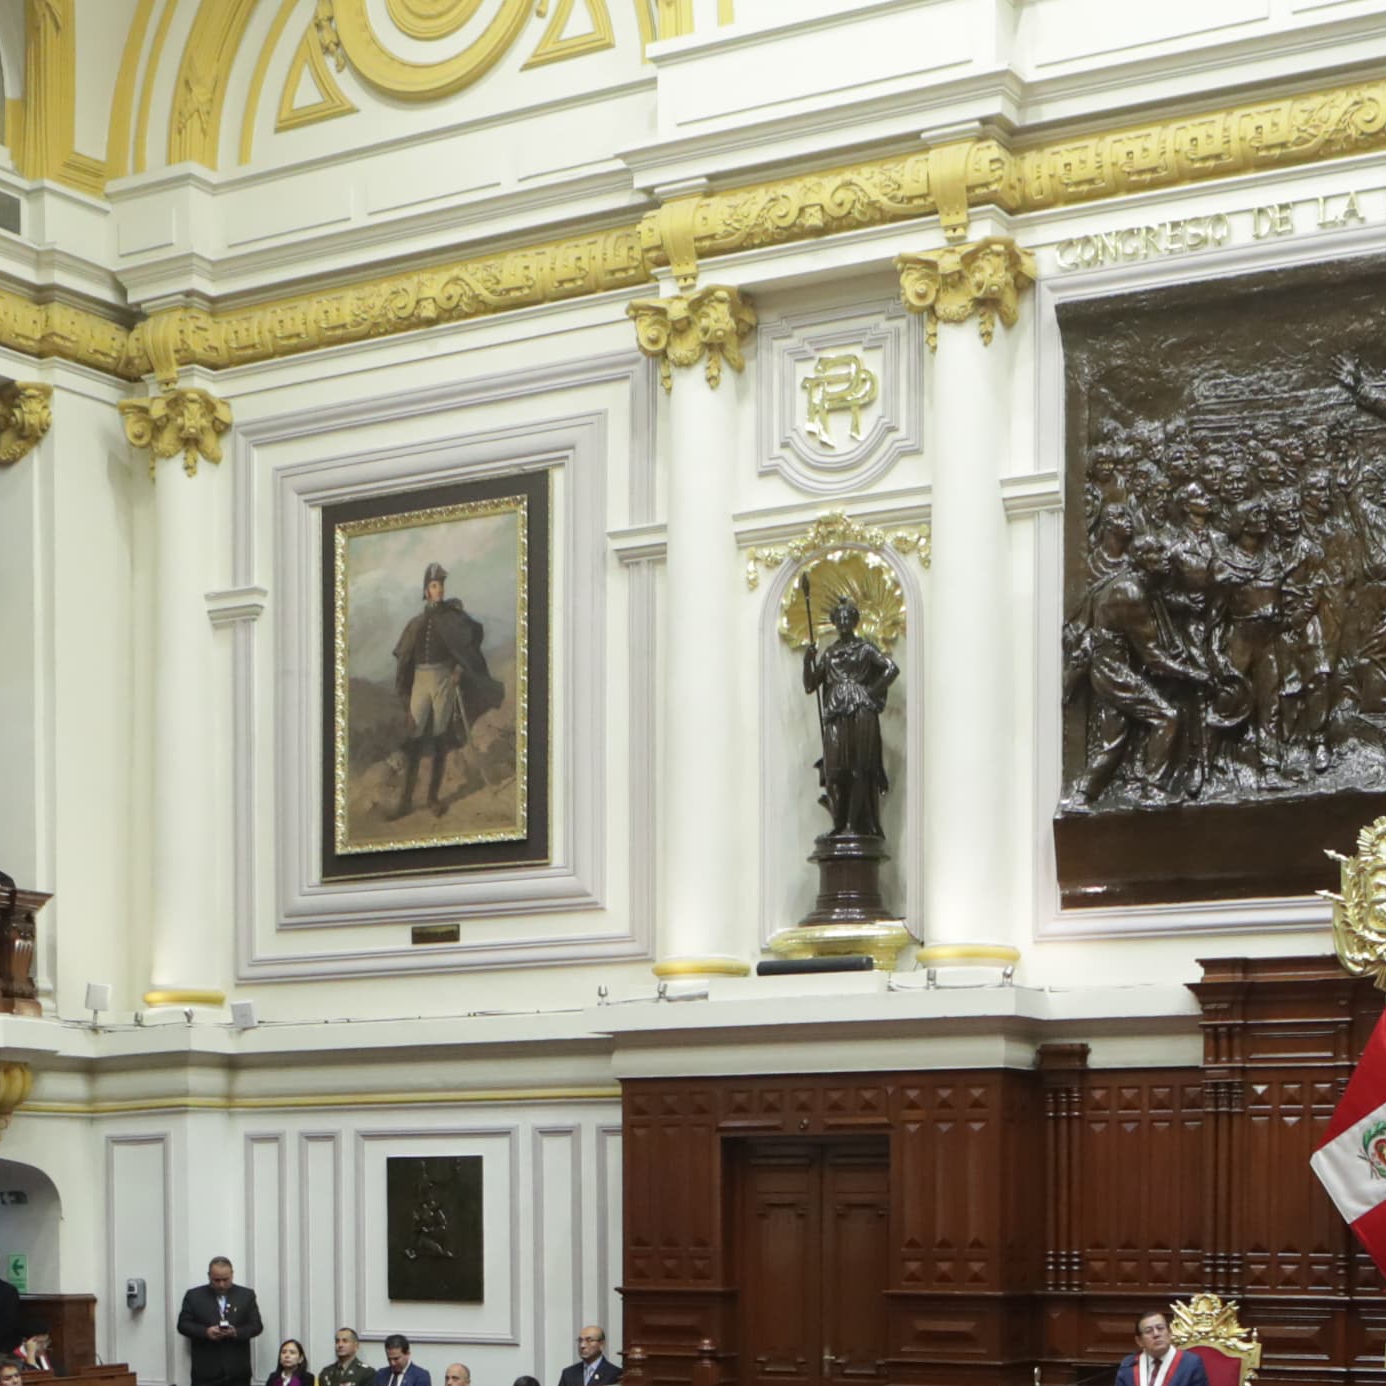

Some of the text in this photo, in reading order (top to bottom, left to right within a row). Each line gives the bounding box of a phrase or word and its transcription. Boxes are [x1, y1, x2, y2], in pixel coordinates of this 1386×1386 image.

[1056, 212, 1231, 269] CONGRESO
[1252, 201, 1294, 240] DE
[1317, 190, 1366, 228] LA
